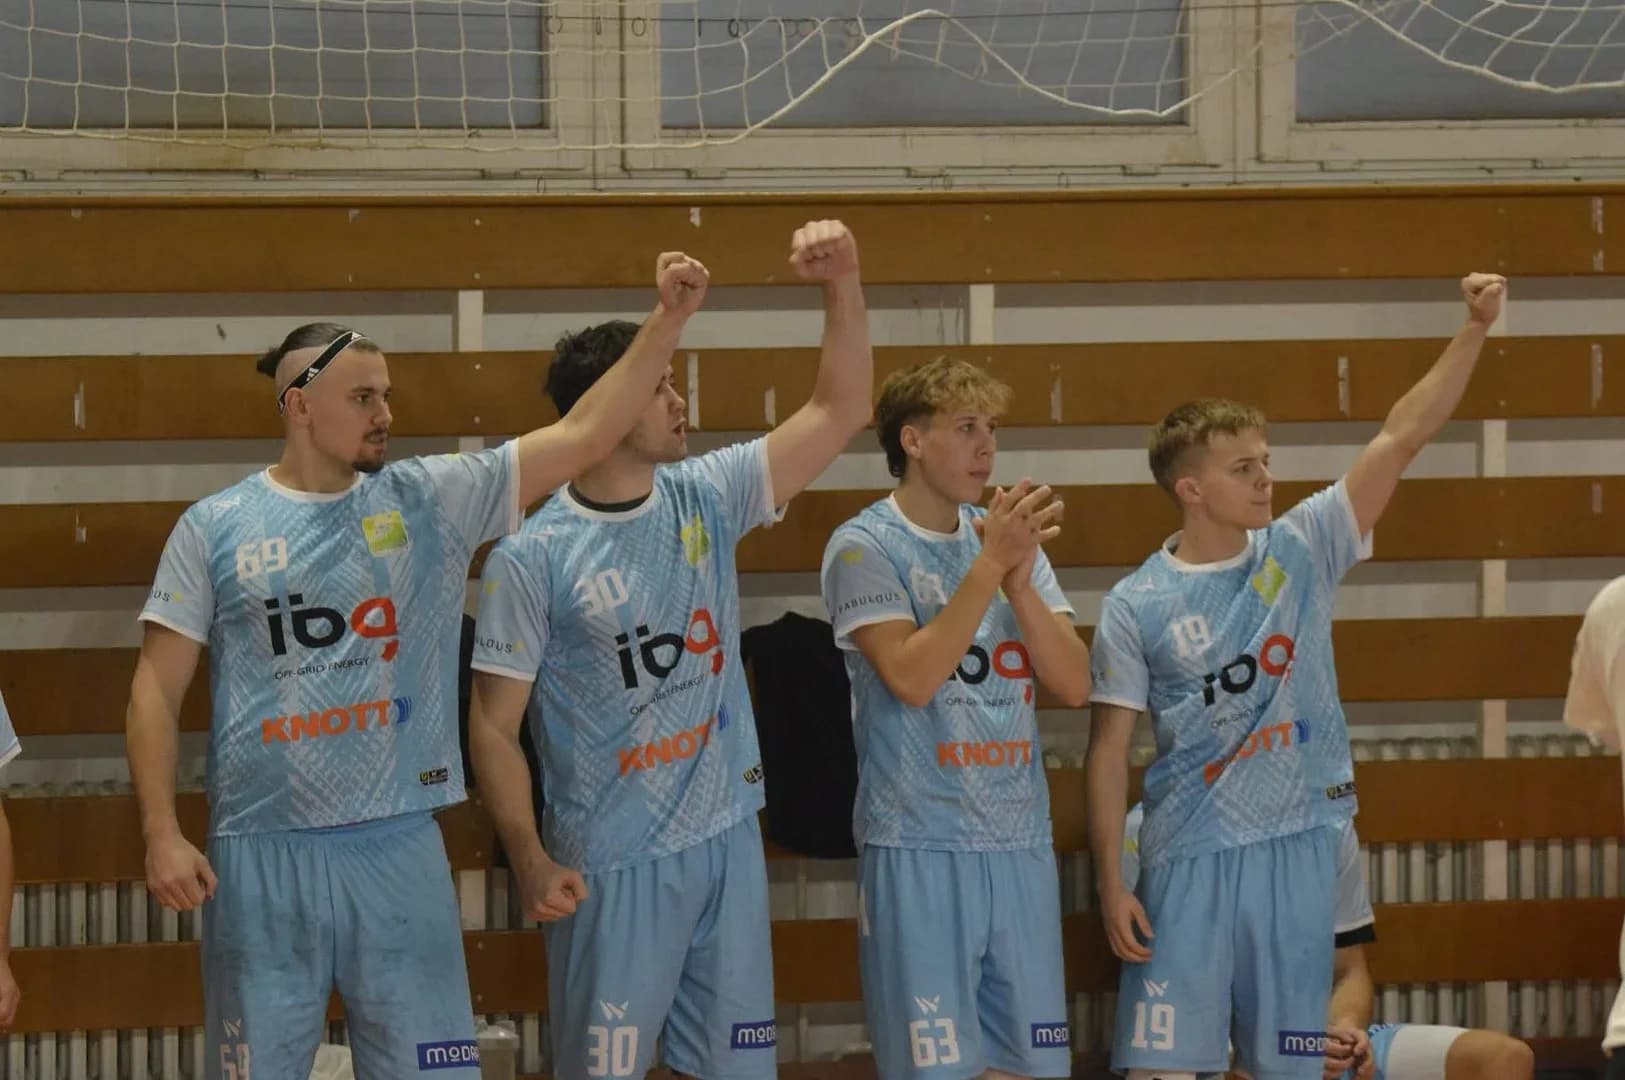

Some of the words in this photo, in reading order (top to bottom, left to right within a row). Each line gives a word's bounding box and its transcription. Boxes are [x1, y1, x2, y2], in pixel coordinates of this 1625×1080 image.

[236, 537, 288, 581] 69
[1171, 615, 1212, 657] 19
[328, 656, 370, 671] ENERGY
[261, 699, 391, 744] KNOTT
[617, 714, 717, 777] KNOT
[936, 740, 1032, 767] KNOTT
[910, 1018, 960, 1068] 63
[1131, 1001, 1174, 1050] 19
[588, 1025, 638, 1076] 30
